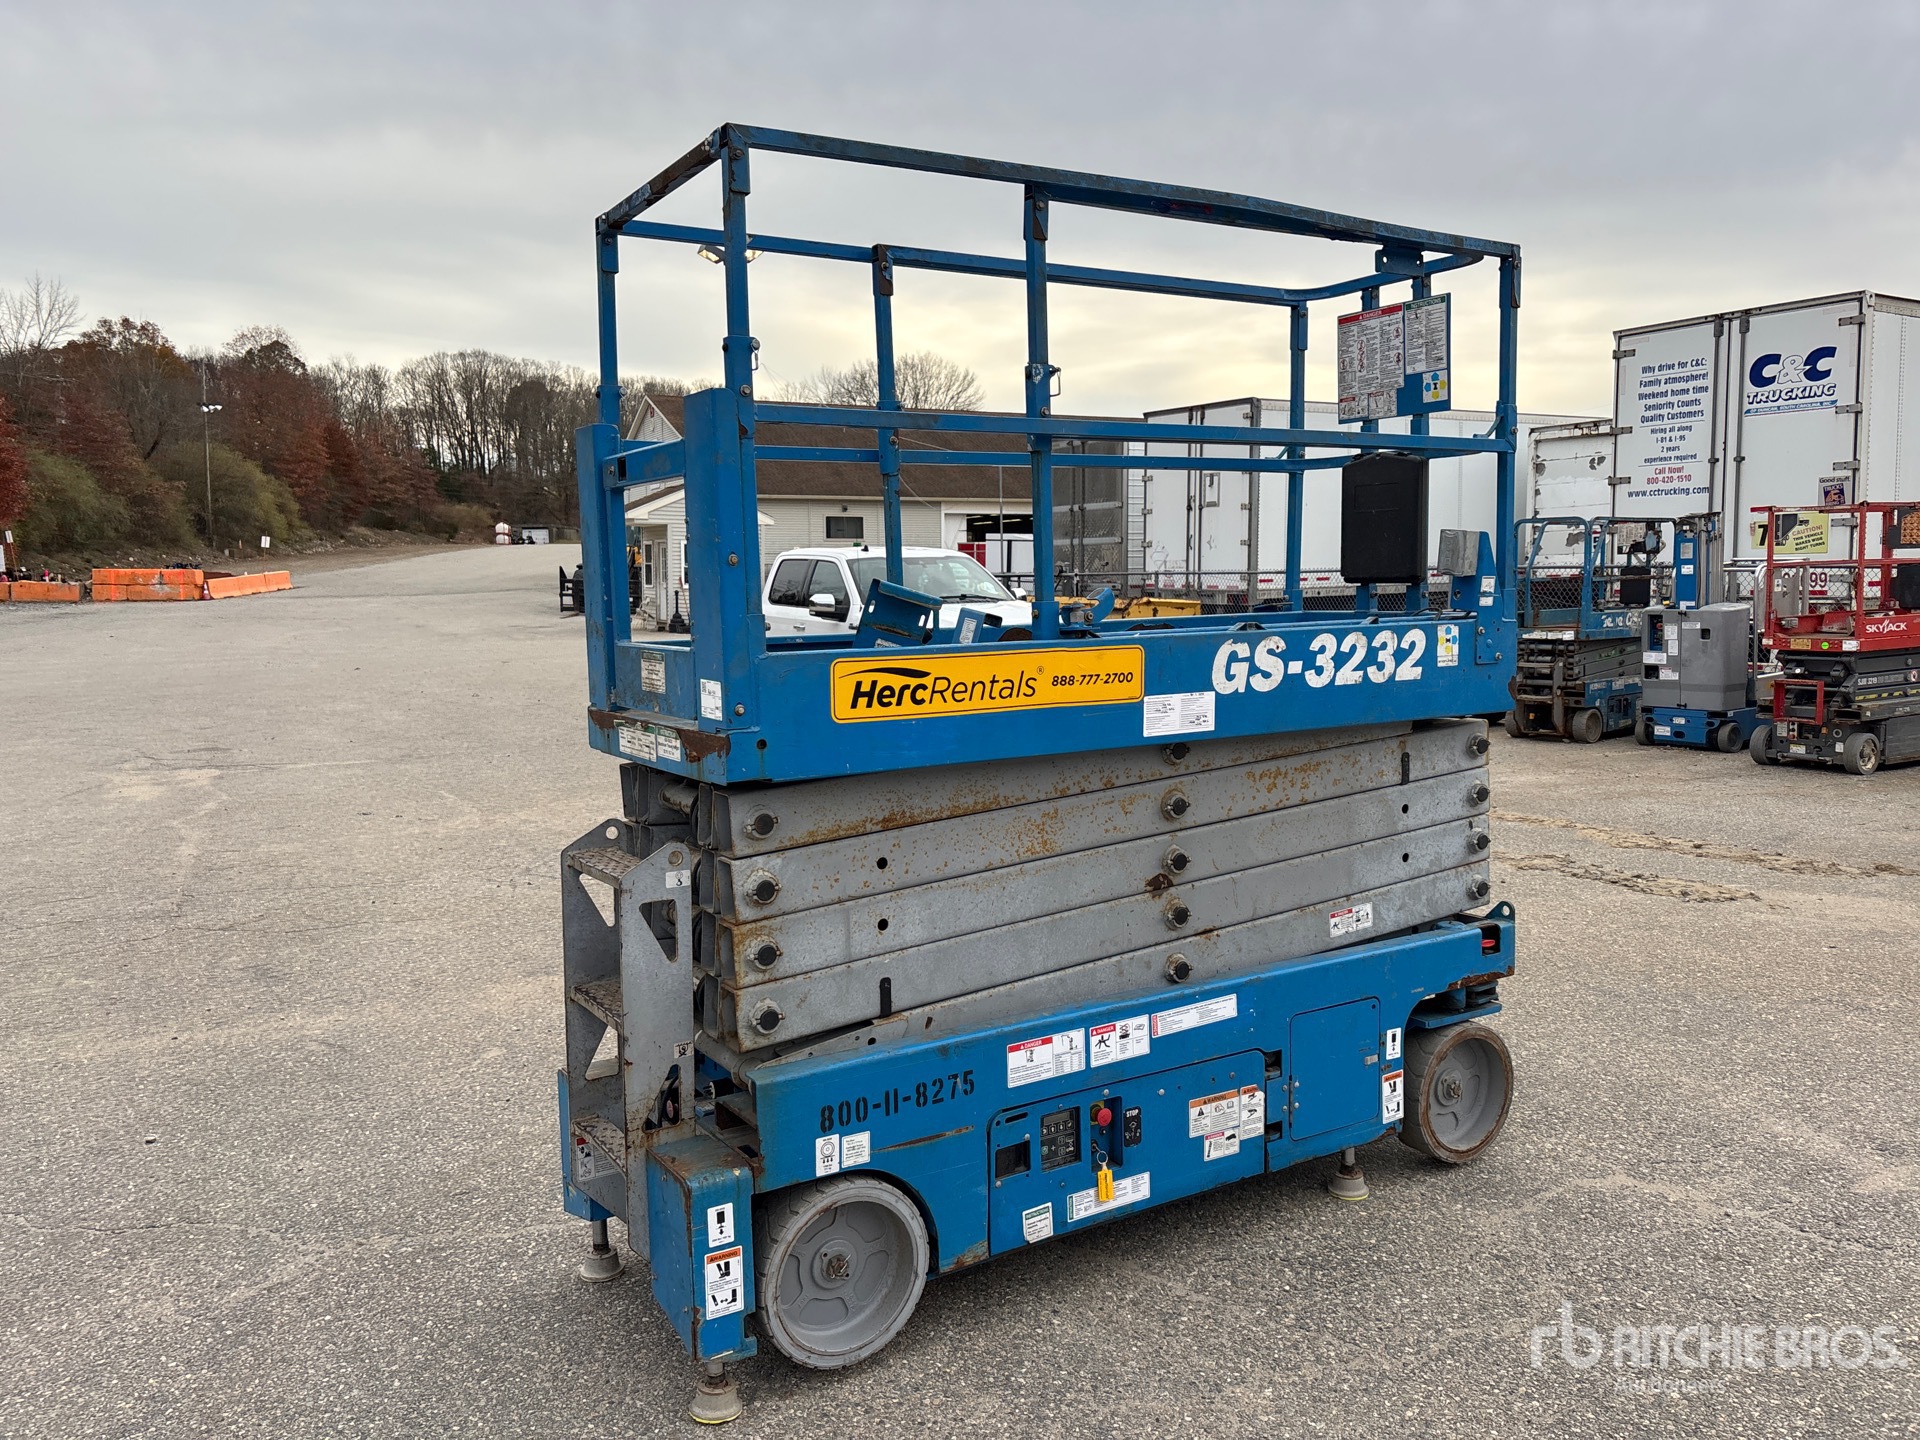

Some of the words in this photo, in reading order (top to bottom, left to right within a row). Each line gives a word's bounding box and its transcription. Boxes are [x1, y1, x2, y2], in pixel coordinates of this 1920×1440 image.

[1642, 365, 1656, 374] Why
[1658, 362, 1676, 372] drive
[1678, 361, 1688, 369] for
[1690, 358, 1707, 367] C&C:
[1749, 346, 1837, 388] C&C
[1640, 378, 1662, 388] Family
[1664, 372, 1708, 386] atmosphere!
[1638, 390, 1668, 401] Weekend
[1670, 388, 1690, 397] home
[1692, 385, 1709, 394] time
[1747, 382, 1837, 405] TRUCKING
[1644, 402, 1675, 412] Seniority
[1676, 398, 1702, 408] Counts
[1640, 414, 1665, 424] Quality
[1667, 410, 1704, 420] Customers
[1656, 436, 1667, 444] I-81
[1644, 456, 1672, 464] experience
[1674, 453, 1697, 462] required
[1654, 467, 1666, 476] Call
[1668, 466, 1684, 474] Now!
[1646, 474, 1692, 485] 800-420-1510
[1628, 486, 1710, 498] www.cctrucking.com
[1792, 524, 1823, 536] CAUTION!
[1804, 532, 1824, 540] VEHICLE
[1812, 536, 1823, 544] WIDE
[1866, 618, 1908, 634] SKYJACK
[1212, 628, 1427, 695] GS-3232
[1051, 671, 1134, 687] 888-777-2700
[1097, 1024, 1115, 1034] DANGER
[1024, 1039, 1042, 1050] DANGER
[1208, 1094, 1226, 1104] WARNING
[1126, 1108, 1139, 1118] STOP
[712, 1251, 738, 1262] WARNING
